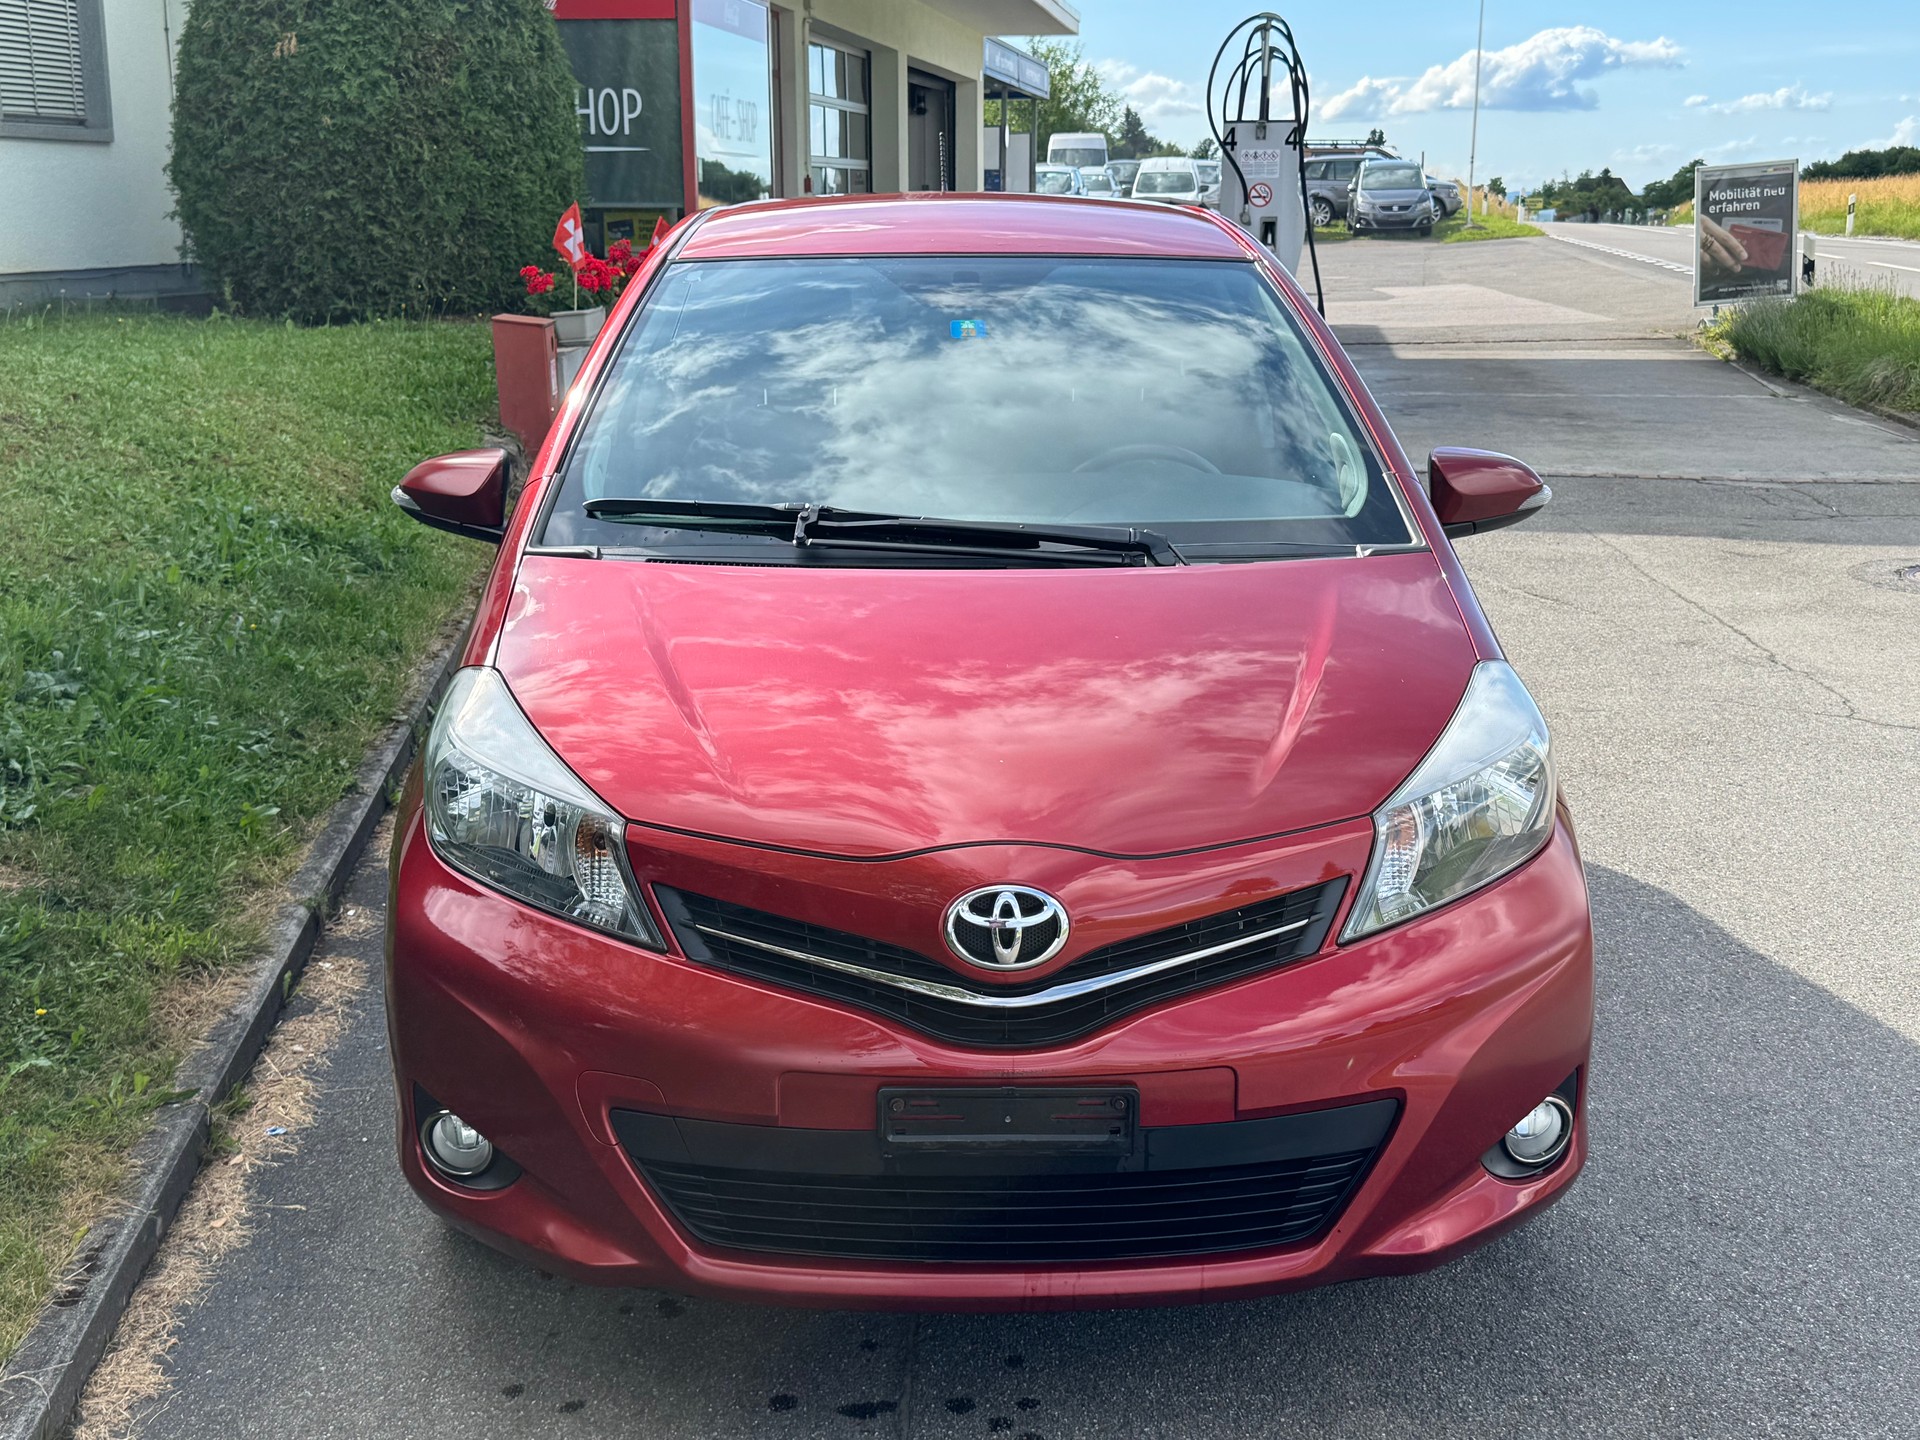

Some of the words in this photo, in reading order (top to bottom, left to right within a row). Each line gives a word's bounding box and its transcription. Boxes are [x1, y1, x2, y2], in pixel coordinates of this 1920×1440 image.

[1223, 127, 1238, 151] 4
[1284, 127, 1300, 151] 4
[1709, 187, 1761, 201] Mobilität
[1763, 186, 1785, 197] neu
[1708, 201, 1760, 214] erfahren
